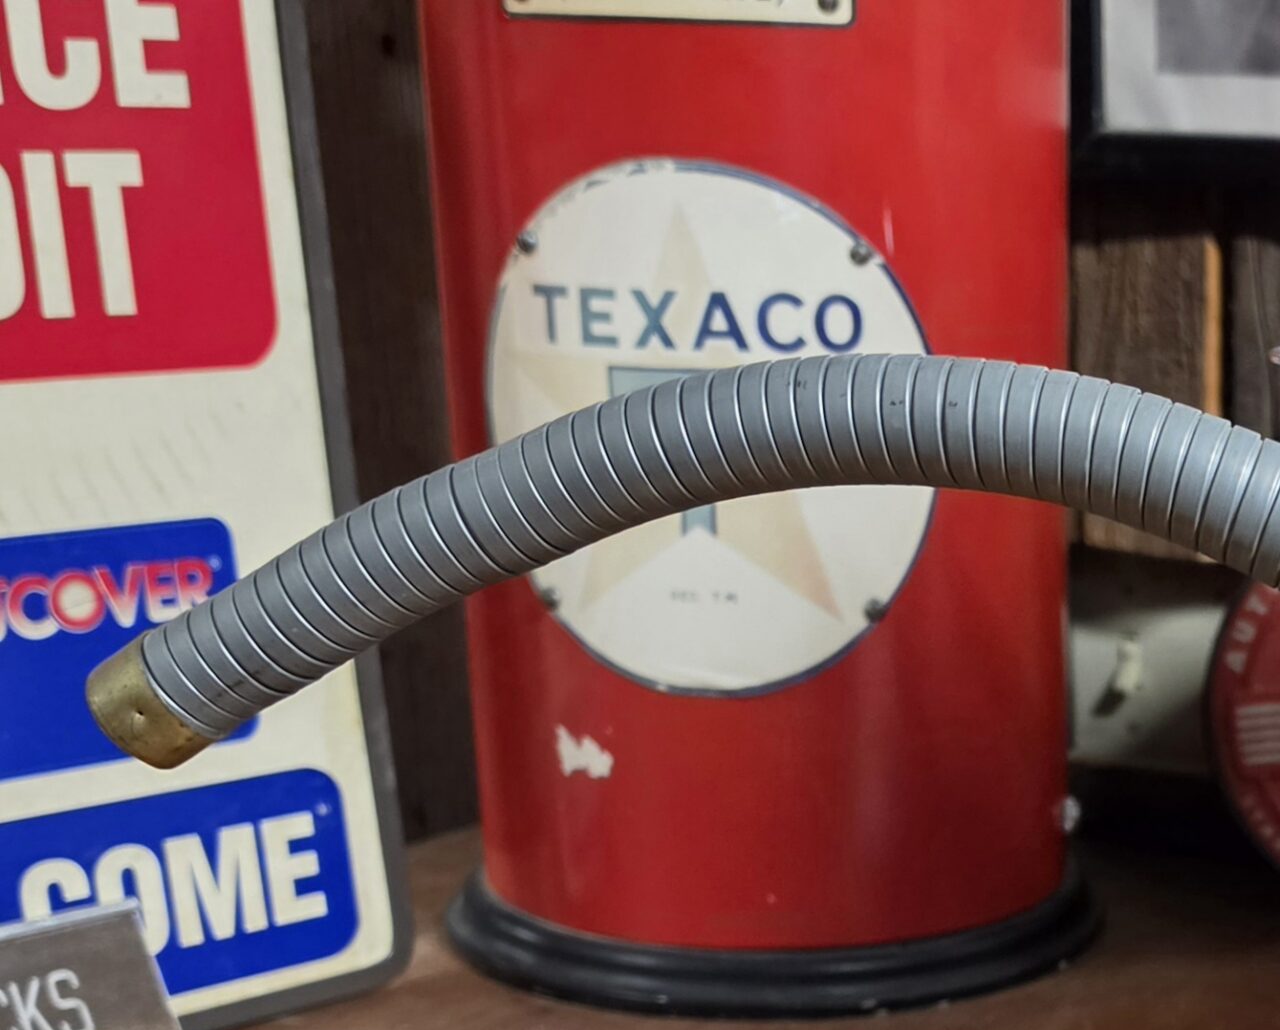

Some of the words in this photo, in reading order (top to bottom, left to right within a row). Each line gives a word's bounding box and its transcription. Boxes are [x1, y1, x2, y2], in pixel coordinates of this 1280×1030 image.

[0, 0, 192, 111] CE
[532, 284, 864, 355] TEXACO
[0, 558, 214, 643] COVER
